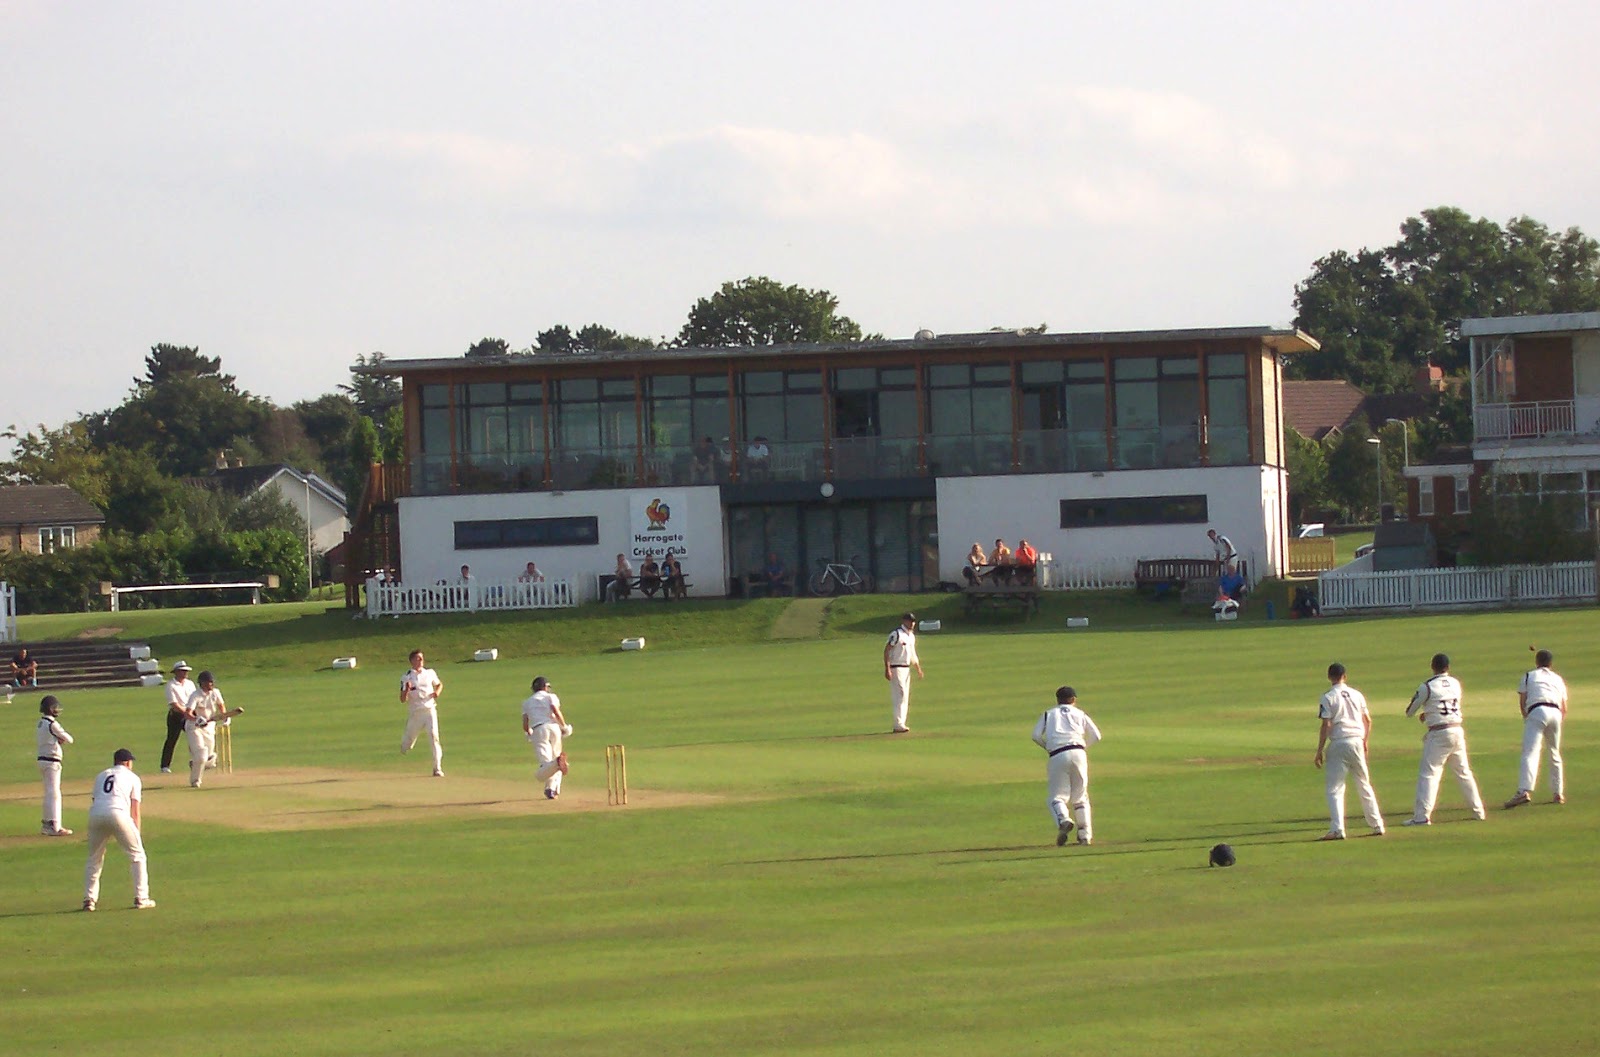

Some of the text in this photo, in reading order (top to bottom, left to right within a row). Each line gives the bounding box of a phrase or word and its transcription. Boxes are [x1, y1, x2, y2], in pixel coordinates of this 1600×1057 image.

[634, 534, 684, 543] Harrogate
[633, 546, 687, 556] Cricket Club
[103, 774, 115, 794] 6
